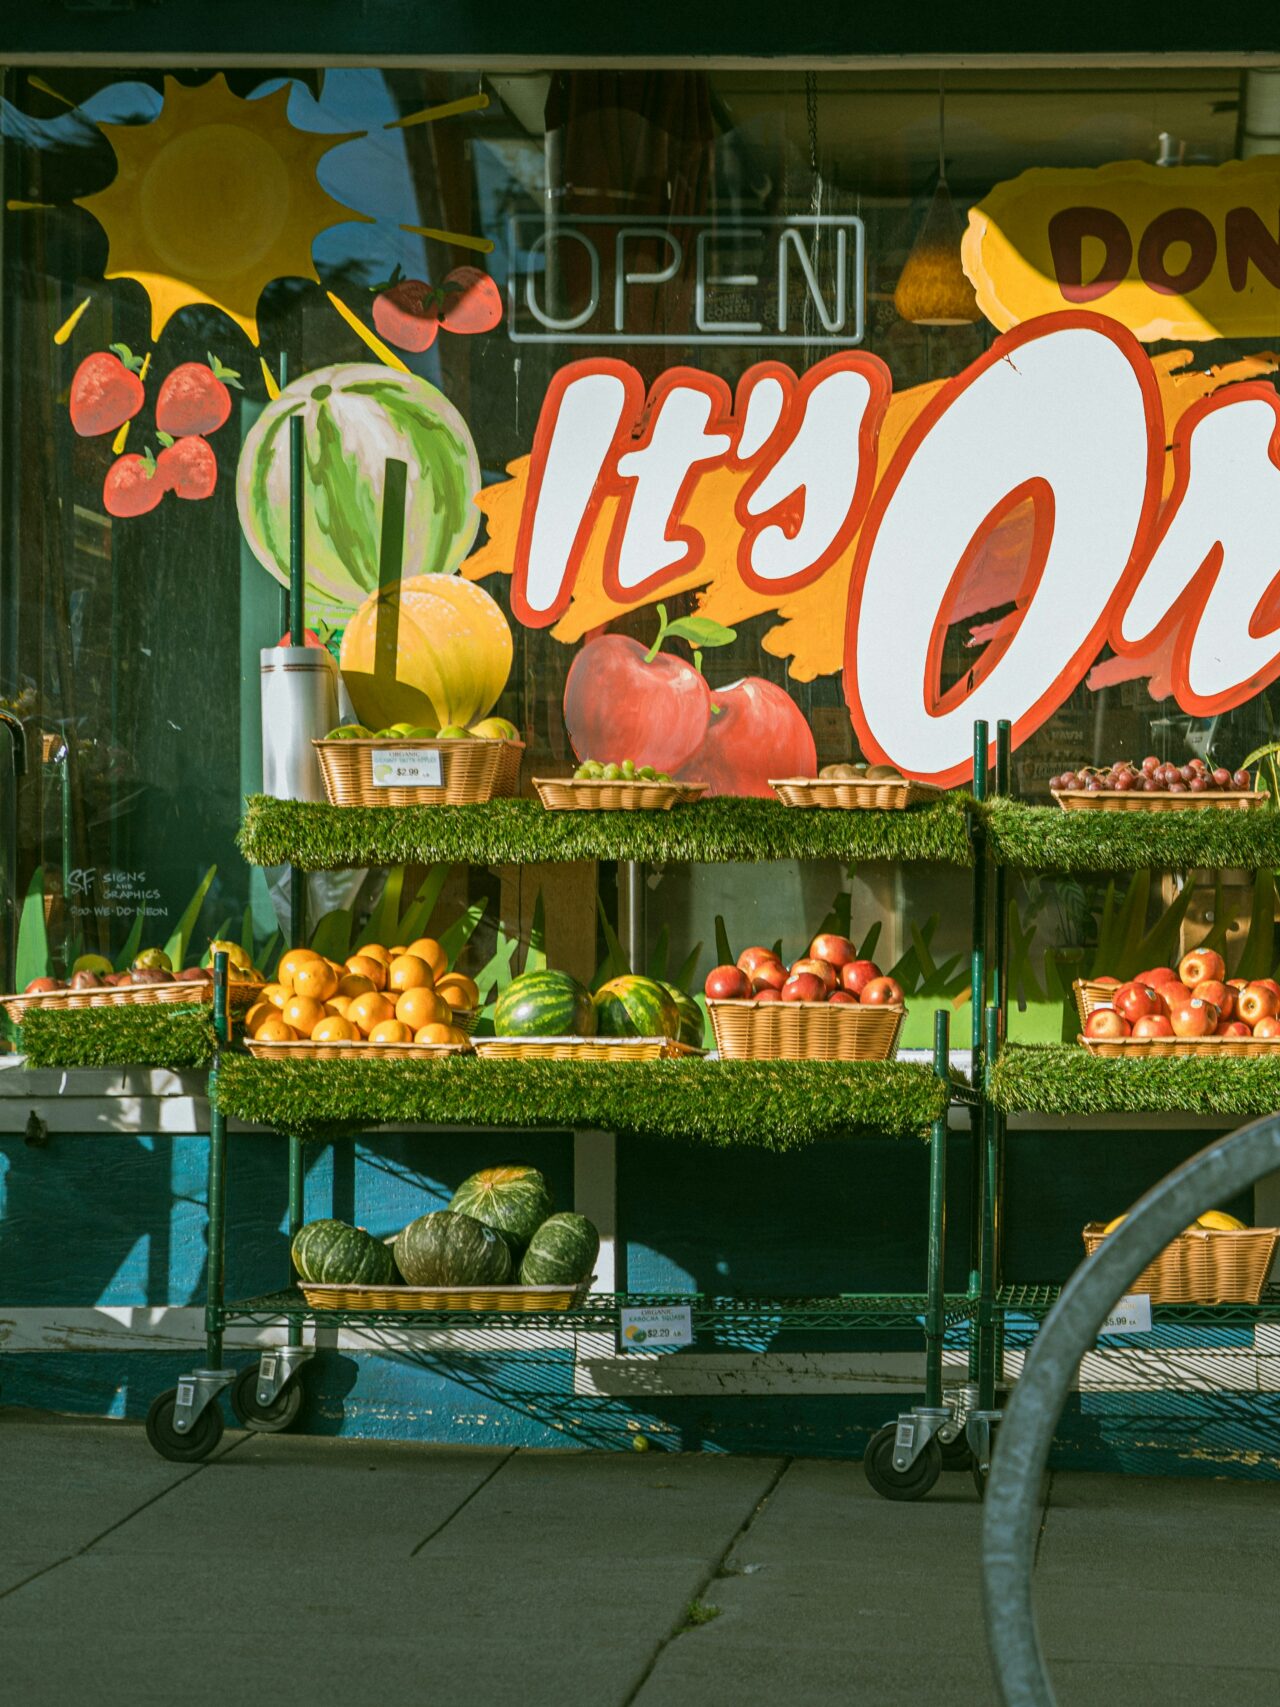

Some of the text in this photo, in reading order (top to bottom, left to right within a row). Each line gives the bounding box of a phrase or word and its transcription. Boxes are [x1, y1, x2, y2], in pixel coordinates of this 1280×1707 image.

[527, 228, 847, 333] OPEN
[510, 350, 893, 628] It's
[397, 768, 419, 776] $2.99
[103, 872, 146, 883] SIGNS
[103, 889, 160, 899] GRAPHICS
[647, 1328, 670, 1338] $2.29
